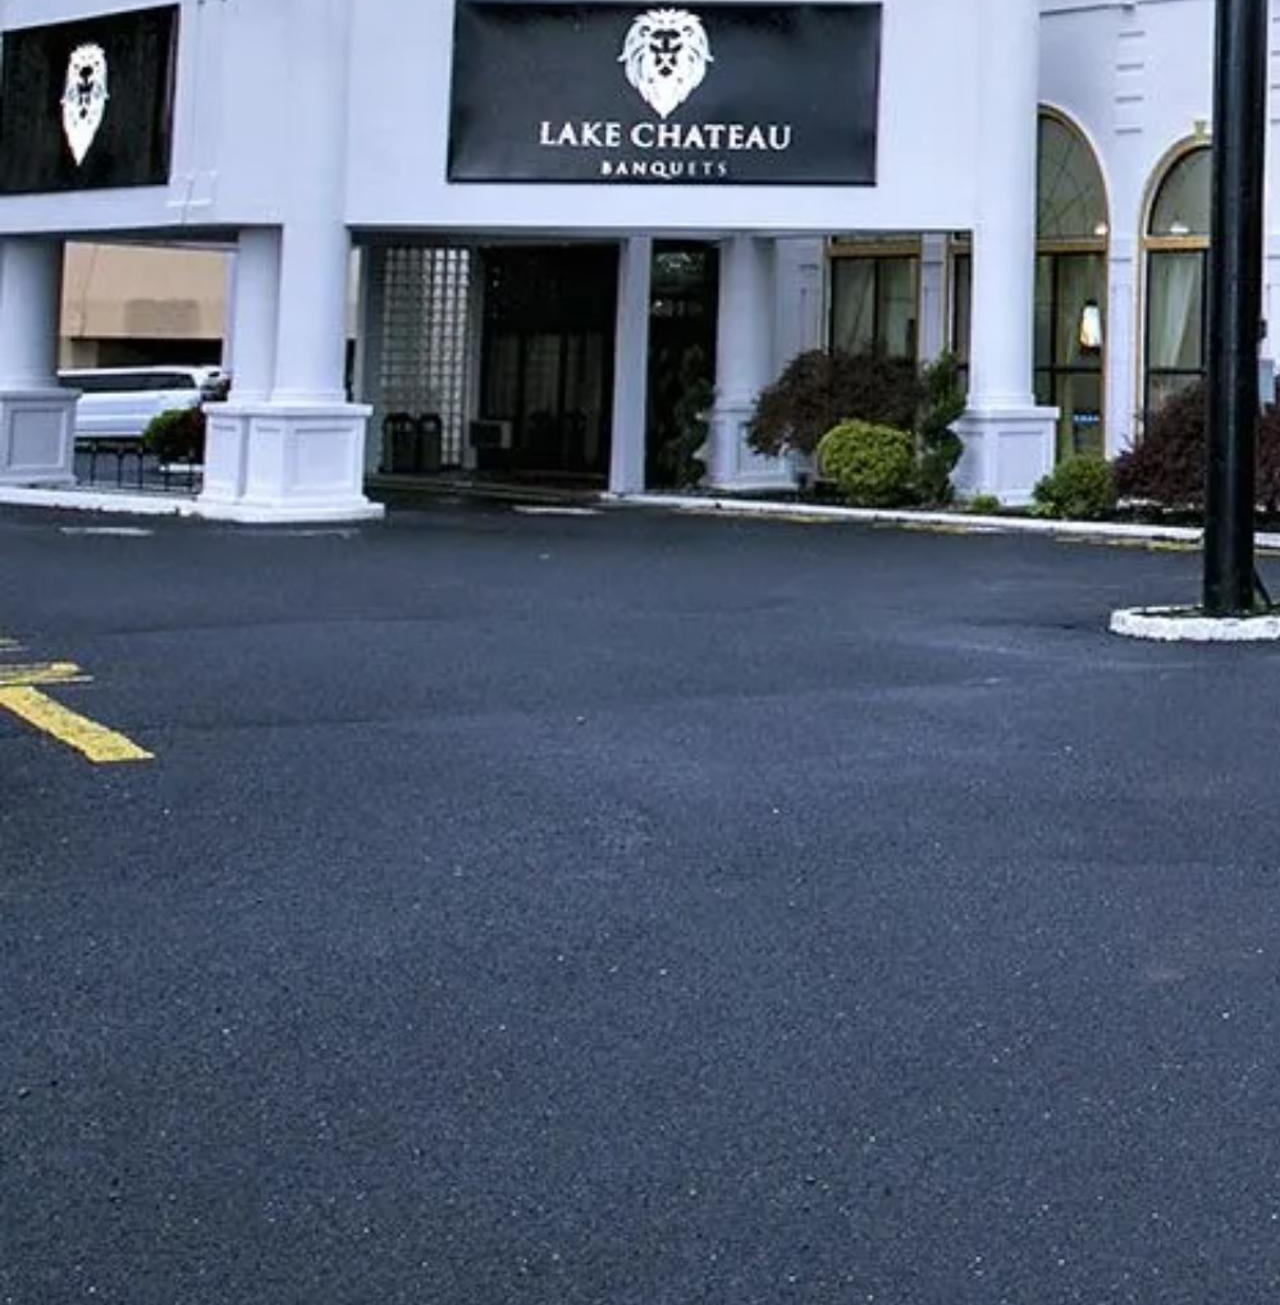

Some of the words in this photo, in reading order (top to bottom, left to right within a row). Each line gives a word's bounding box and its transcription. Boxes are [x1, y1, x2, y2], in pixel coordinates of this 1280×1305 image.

[539, 121, 622, 147] LAKE
[630, 122, 792, 151] CHATEAU
[601, 161, 728, 179] BANQUETS
